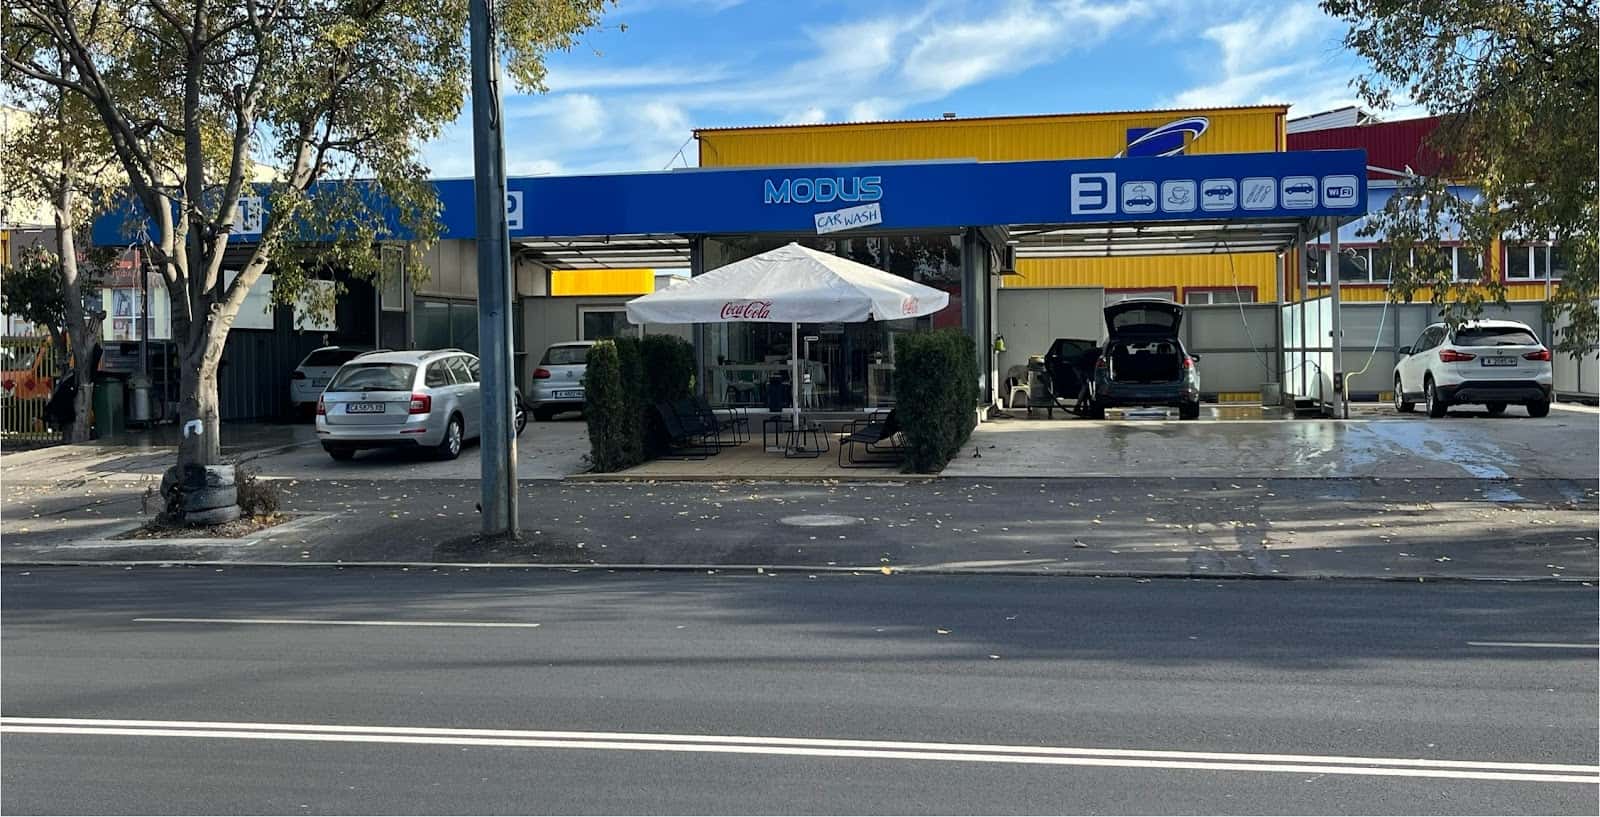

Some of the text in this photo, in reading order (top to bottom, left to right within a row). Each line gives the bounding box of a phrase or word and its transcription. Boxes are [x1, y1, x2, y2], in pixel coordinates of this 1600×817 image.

[764, 176, 883, 204] MODUS
[1079, 177, 1108, 211] 3
[817, 209, 877, 228] CAR WASH
